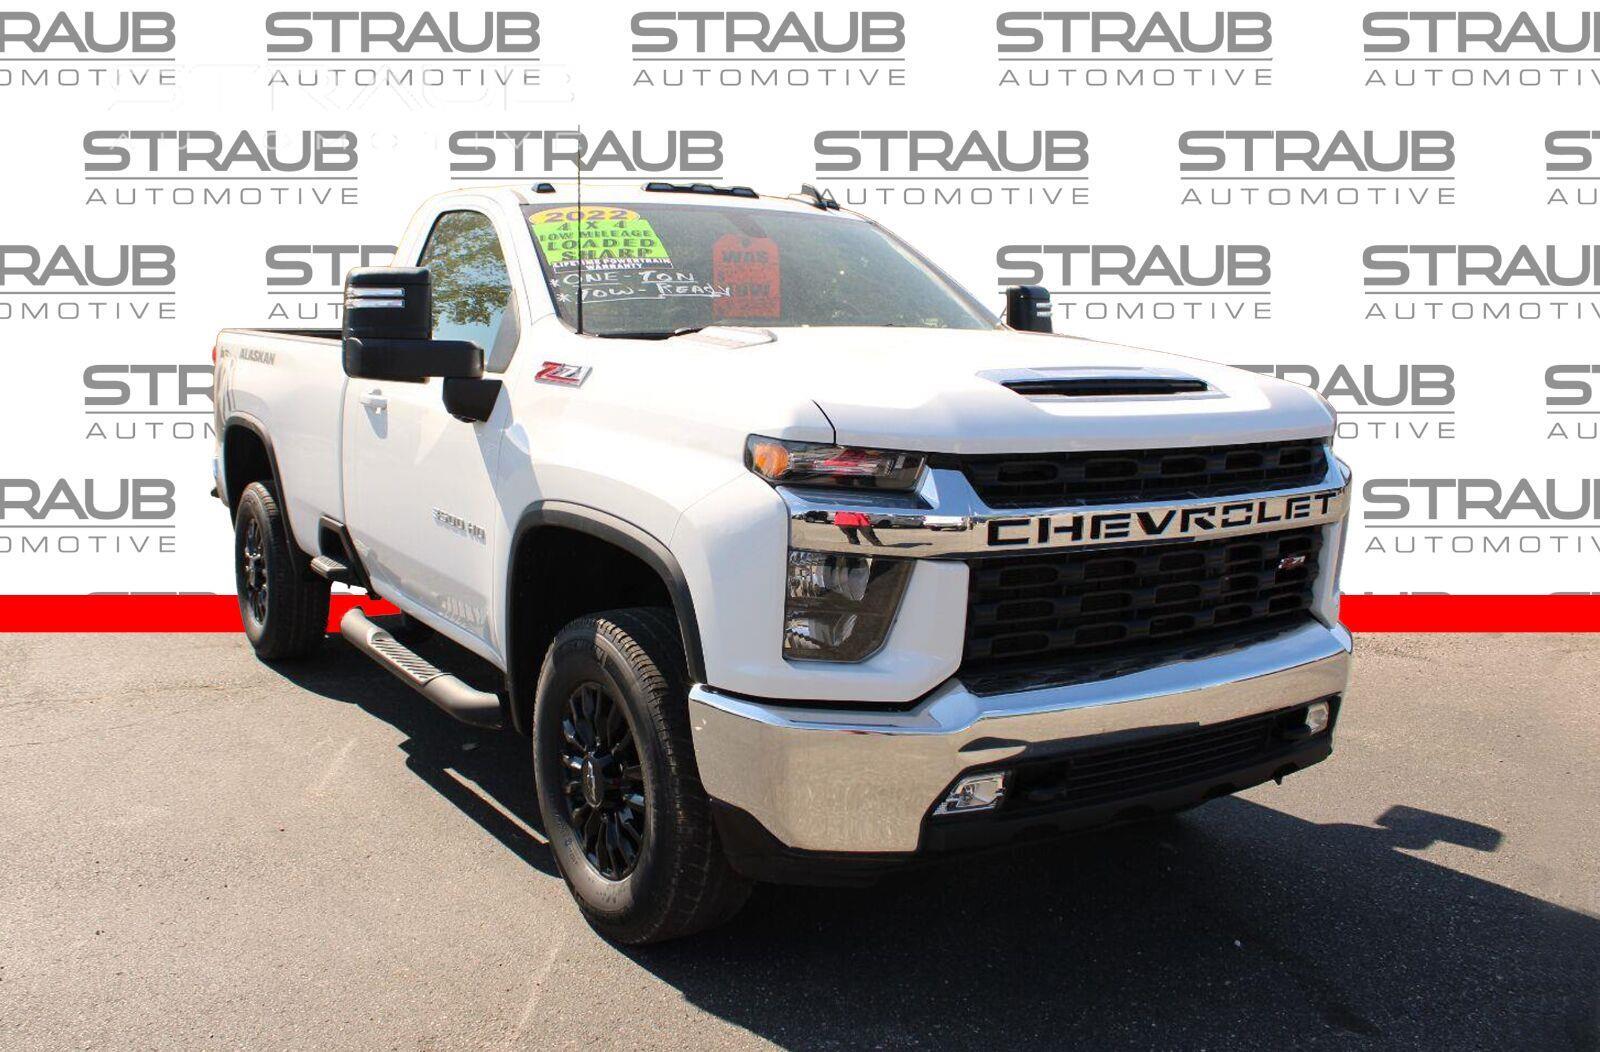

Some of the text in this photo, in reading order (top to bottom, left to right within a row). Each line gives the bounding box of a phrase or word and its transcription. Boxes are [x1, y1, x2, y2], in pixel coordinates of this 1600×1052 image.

[266, 11, 541, 53] STRAUB
[631, 11, 905, 53] STRAUB
[996, 11, 1272, 53] STRAUB
[1363, 11, 1600, 53] STRAU
[268, 69, 540, 86] AUTOMOTIVE
[633, 69, 905, 86] AUTOMOTIVE
[999, 69, 1272, 86] AUTOMOTIVE
[83, 130, 358, 172] STRAUB
[449, 130, 723, 172] STRAUB
[814, 130, 1089, 172] STRAUB
[1179, 130, 1455, 172] STRAUB
[86, 188, 358, 205] AUTOMOTIVE
[817, 188, 1089, 205] AUTOMOTIVE
[1181, 188, 1455, 205] AUTOMOTIVE
[545, 210, 628, 222] 2022
[540, 230, 651, 241] LOW MILEAGE
[547, 239, 655, 251] LOADED
[562, 248, 653, 260] SHARP
[997, 245, 1272, 286] STRAUB
[1363, 245, 1600, 286] STRAU
[1000, 303, 1272, 319] TOMOTIVE
[239, 347, 276, 365] ALASKAN
[1363, 478, 1600, 520] STRAU
[987, 493, 1338, 546] CHEVROLET
